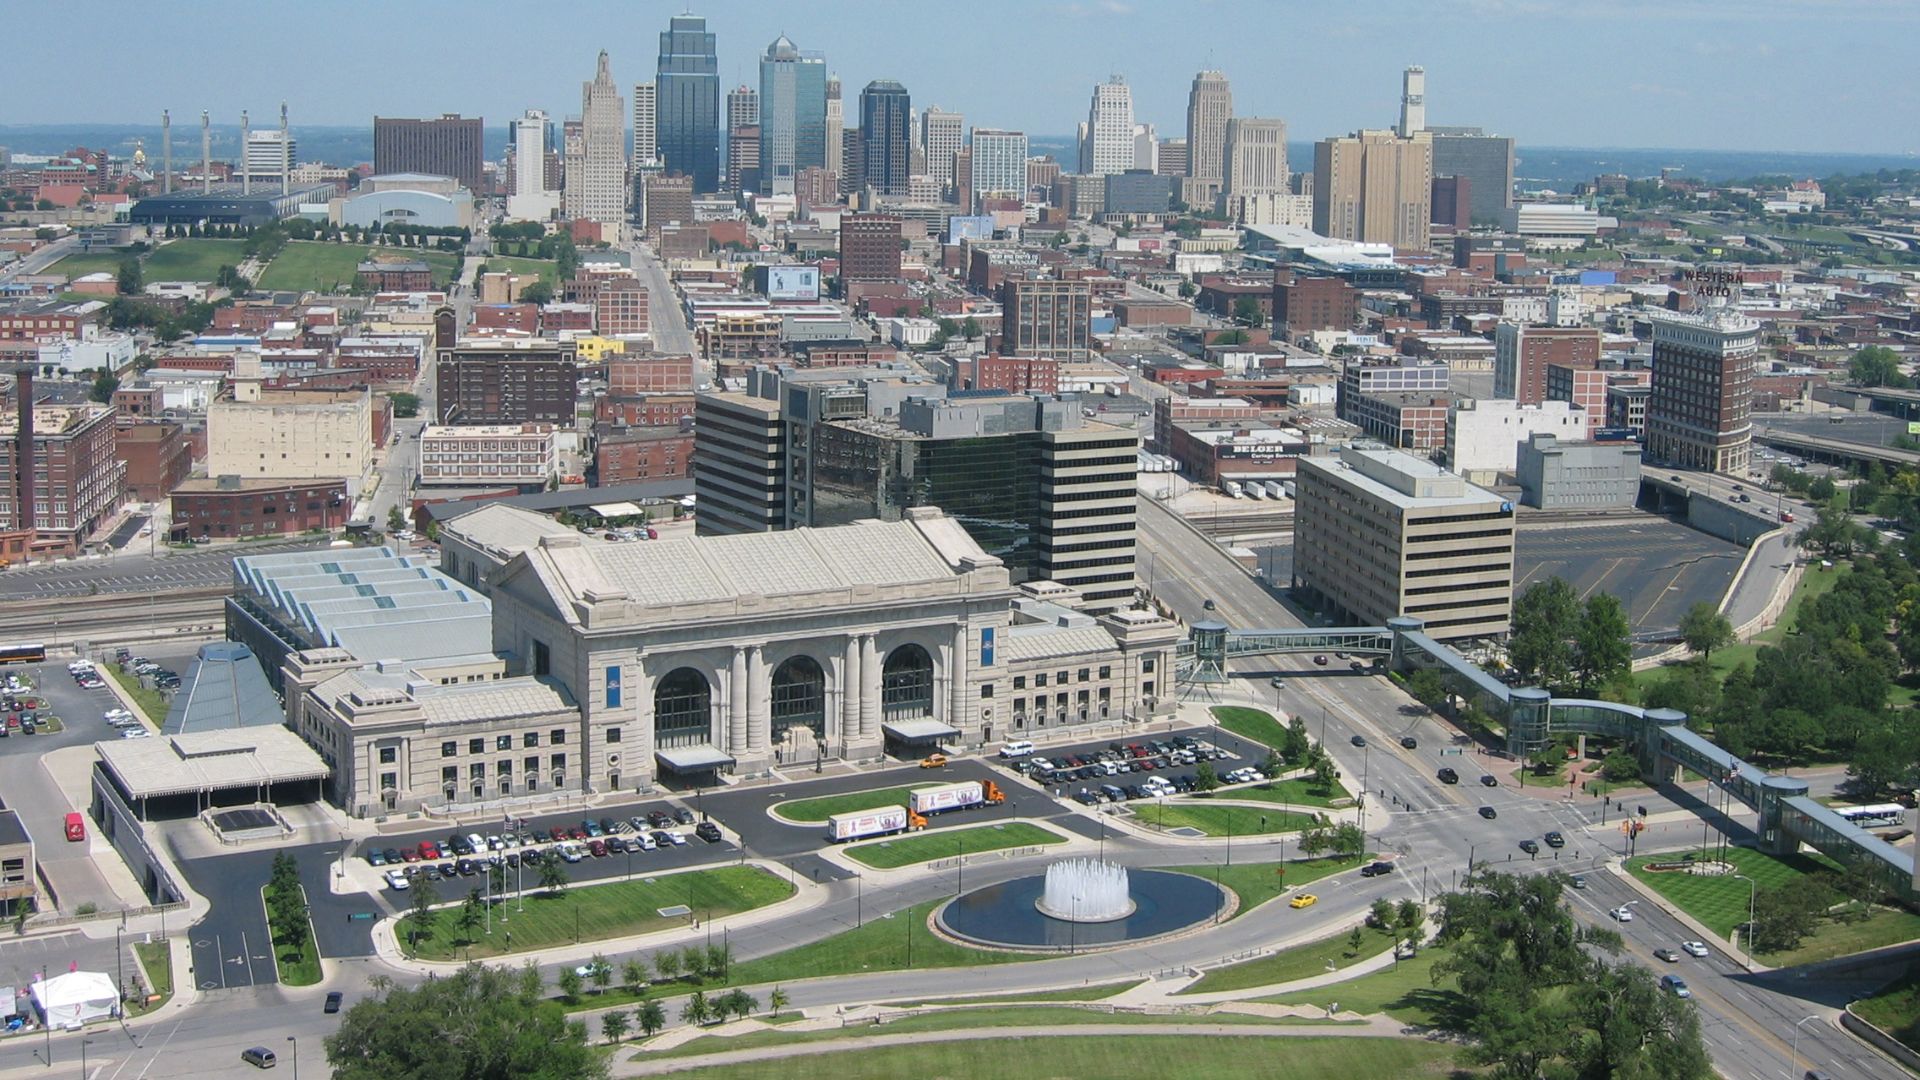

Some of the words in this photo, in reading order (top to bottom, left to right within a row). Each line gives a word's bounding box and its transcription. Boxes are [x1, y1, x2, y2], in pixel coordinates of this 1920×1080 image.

[1684, 270, 1743, 285] WESTERN
[1697, 286, 1730, 297] AUTO
[1233, 445, 1284, 453] BELGER
